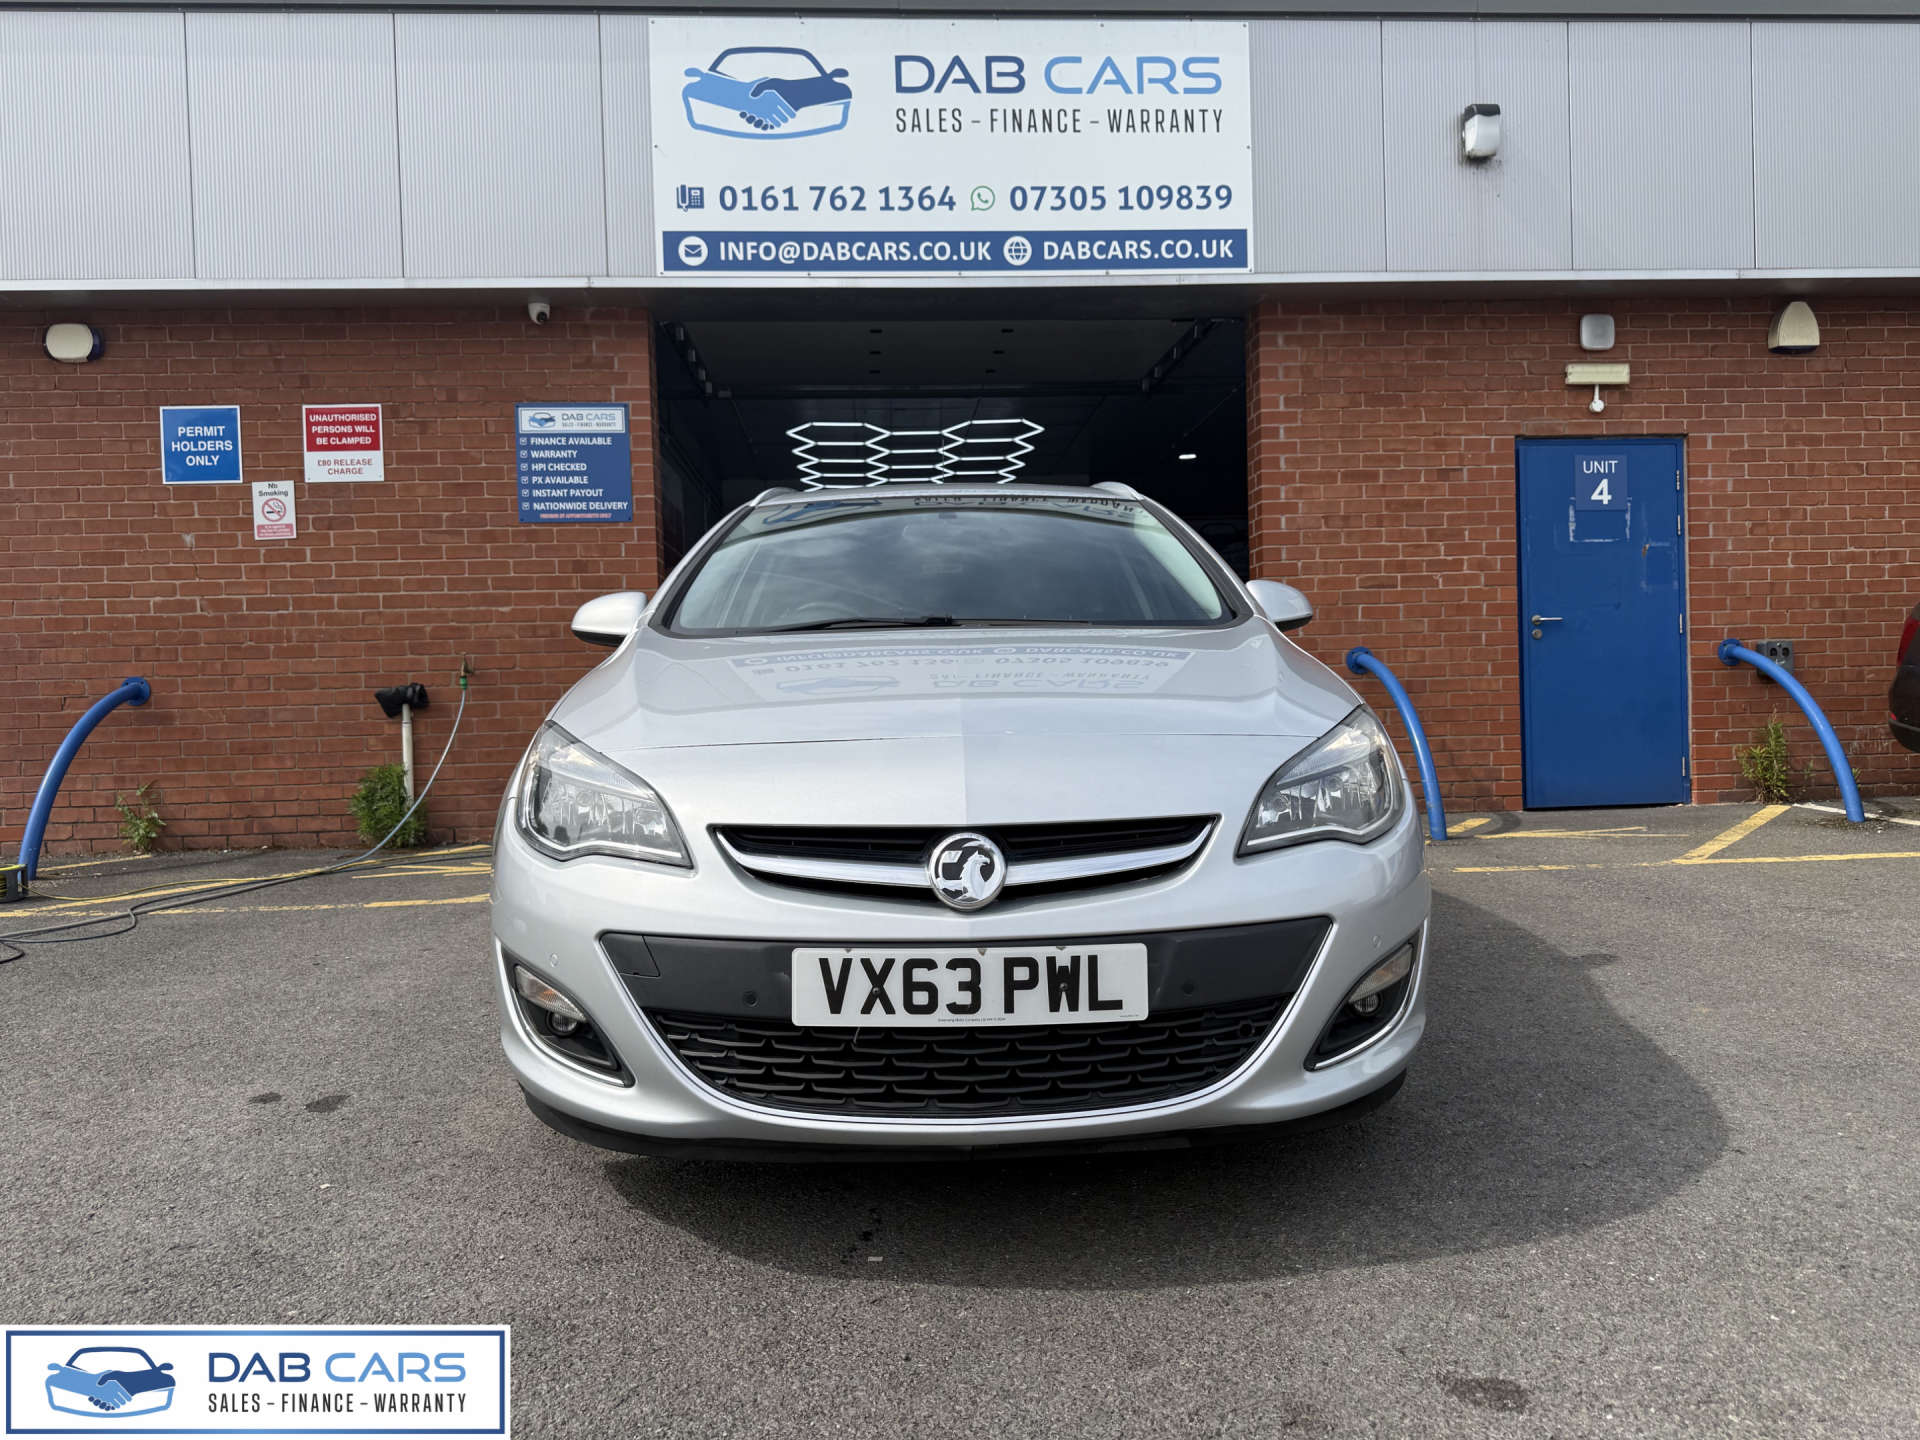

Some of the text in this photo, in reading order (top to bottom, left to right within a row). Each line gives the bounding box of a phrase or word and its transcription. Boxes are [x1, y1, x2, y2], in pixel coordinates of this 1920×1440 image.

[894, 55, 1223, 95] DAB CARS
[895, 108, 963, 133] SALES
[990, 109, 1081, 133] FINANCE
[1107, 108, 1223, 133] WARRANTY
[718, 186, 957, 212] 0161 762 1364
[1009, 184, 1233, 211] 07305 109839
[719, 240, 992, 264] INFO@DABCARS.CO.UK
[1043, 238, 1234, 261] DABCARS.CO.UK
[309, 413, 377, 422] UNAUTHORISED
[177, 425, 225, 437] PERMIT
[311, 425, 376, 434] PERSONS WILL
[316, 436, 372, 445] BE CLAMPED
[530, 437, 613, 446] FINANCE AVAILABLE
[171, 440, 233, 452] HOLDERS
[530, 450, 578, 458] WARRANTY
[185, 455, 219, 467] ONLY
[333, 458, 373, 466] RELEASE
[327, 467, 364, 475] CHARGE
[531, 463, 587, 471] HPI CHECKED
[1582, 460, 1619, 474] UNIT
[532, 476, 589, 484] PX AVAILABLE
[258, 490, 289, 498] Smoking
[532, 489, 604, 497] INSTANT PAYOUT
[1590, 478, 1612, 504] 4
[533, 502, 629, 510] NATIONWIDE DELIVERY
[818, 954, 1123, 1015] VX63 PWL
